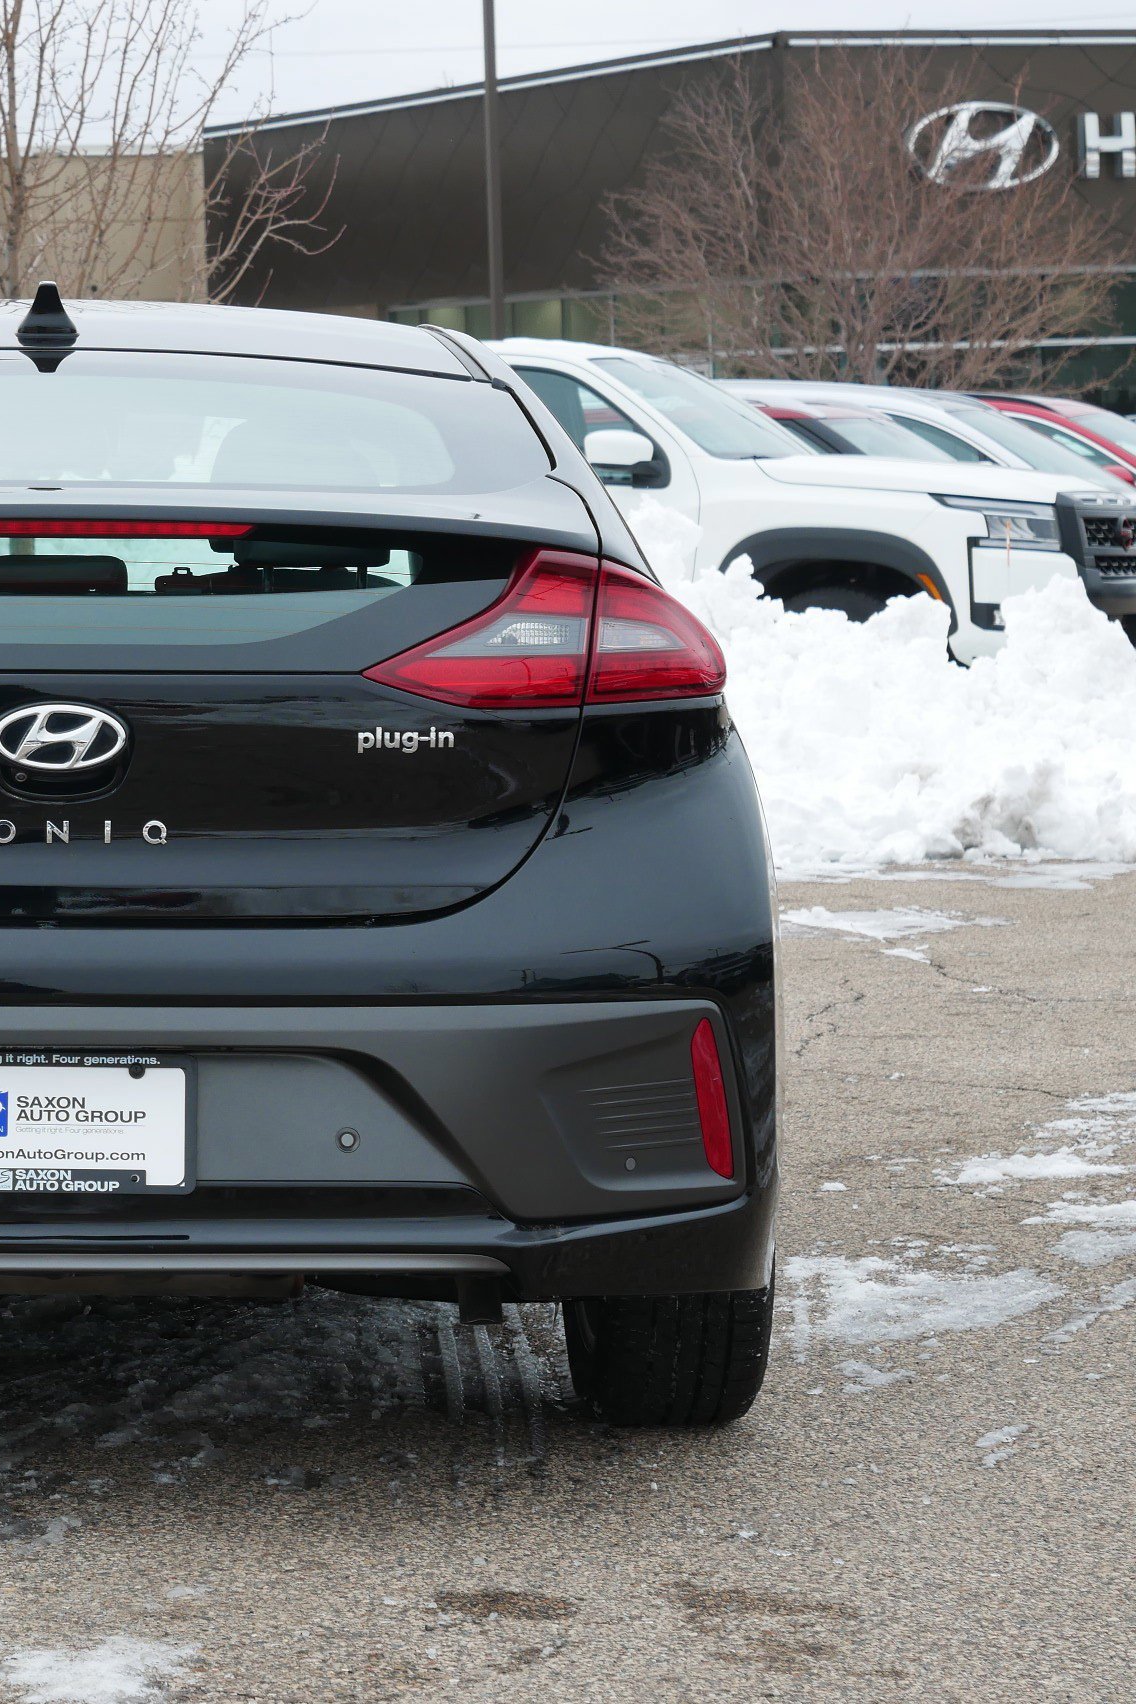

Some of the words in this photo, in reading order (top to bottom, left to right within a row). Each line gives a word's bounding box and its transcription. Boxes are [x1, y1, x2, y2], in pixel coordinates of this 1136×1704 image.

[357, 726, 455, 754] plug-in
[5, 1053, 15, 1063] it
[16, 1053, 49, 1066] right.
[52, 1054, 81, 1064] Four
[83, 1054, 161, 1067] generations.
[15, 1095, 86, 1110] SAXON
[15, 1109, 70, 1122] AUTO
[75, 1110, 147, 1124] GROUP
[14, 1169, 72, 1181] SAXON
[14, 1180, 60, 1191] AUTO
[61, 1180, 121, 1192] GROUP
